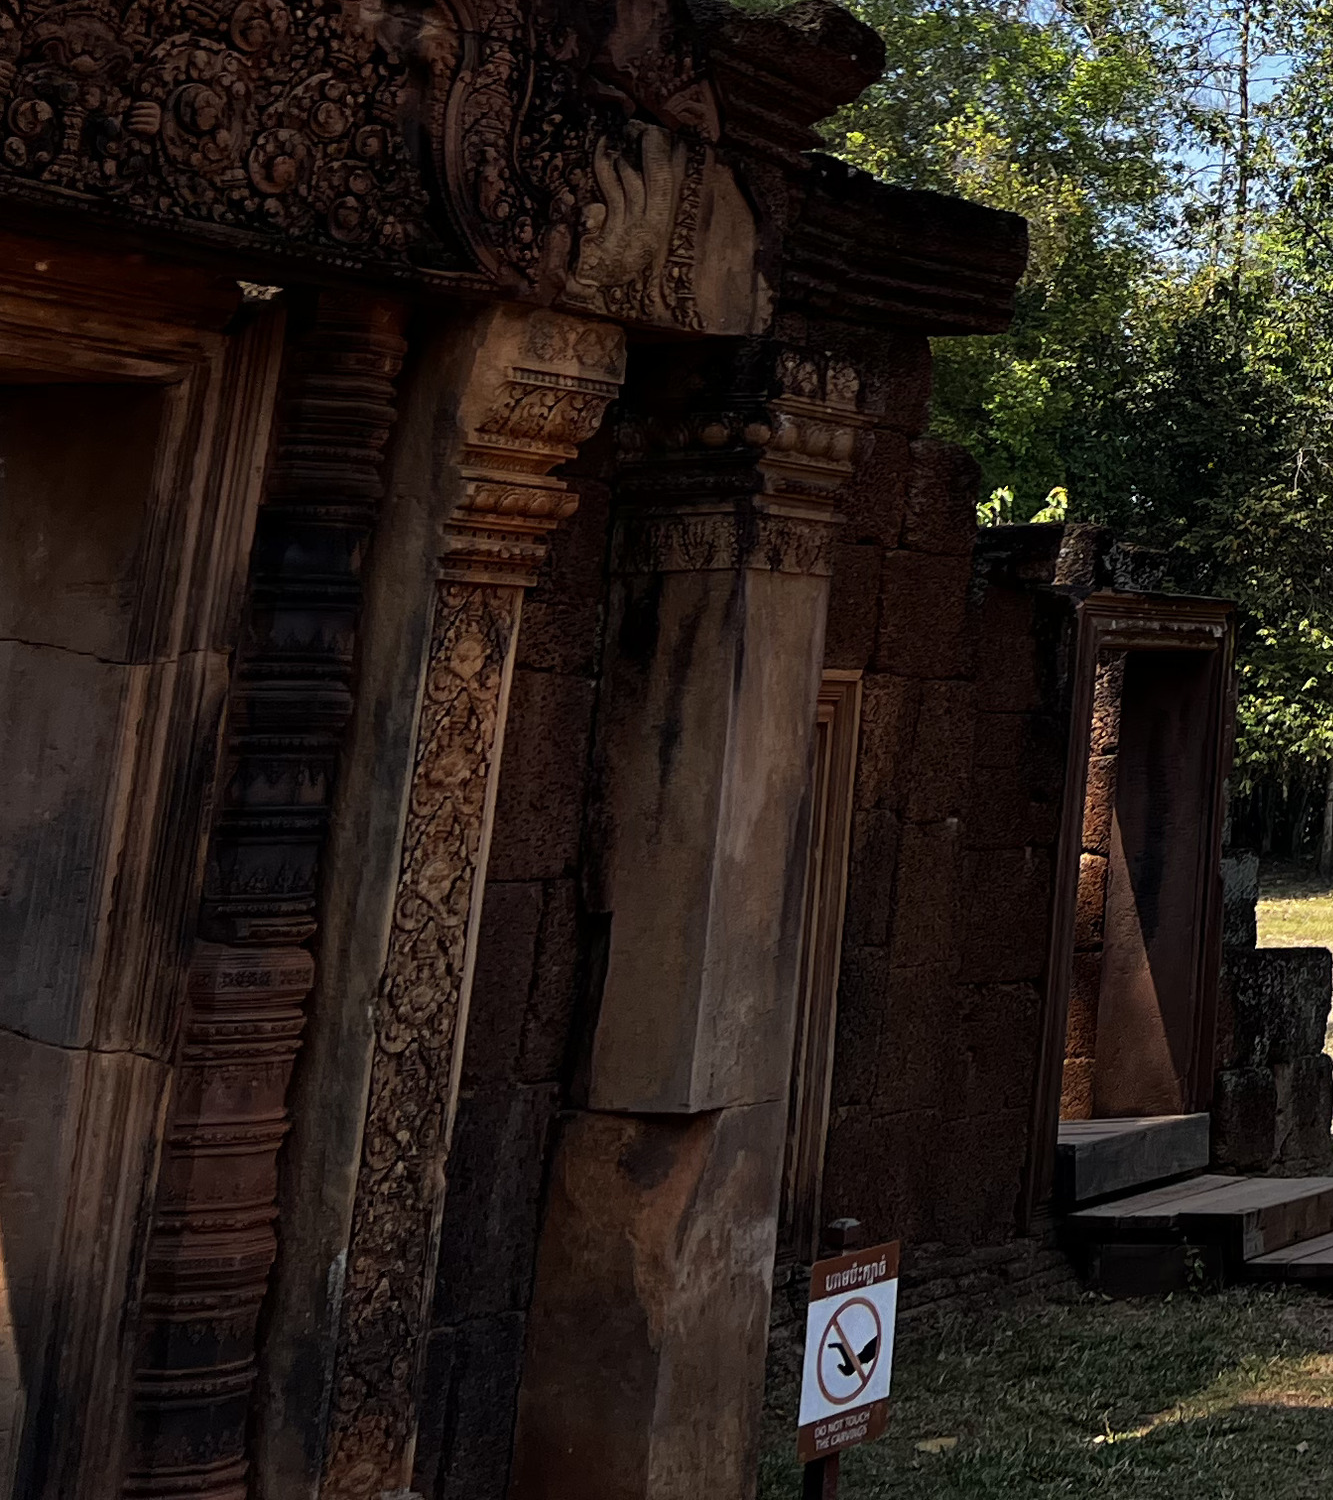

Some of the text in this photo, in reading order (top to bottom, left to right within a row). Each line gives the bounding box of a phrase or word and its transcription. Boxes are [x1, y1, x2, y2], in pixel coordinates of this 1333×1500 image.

[814, 1411, 870, 1439] DO NOT TOUCH
[816, 1436, 830, 1451] THE
